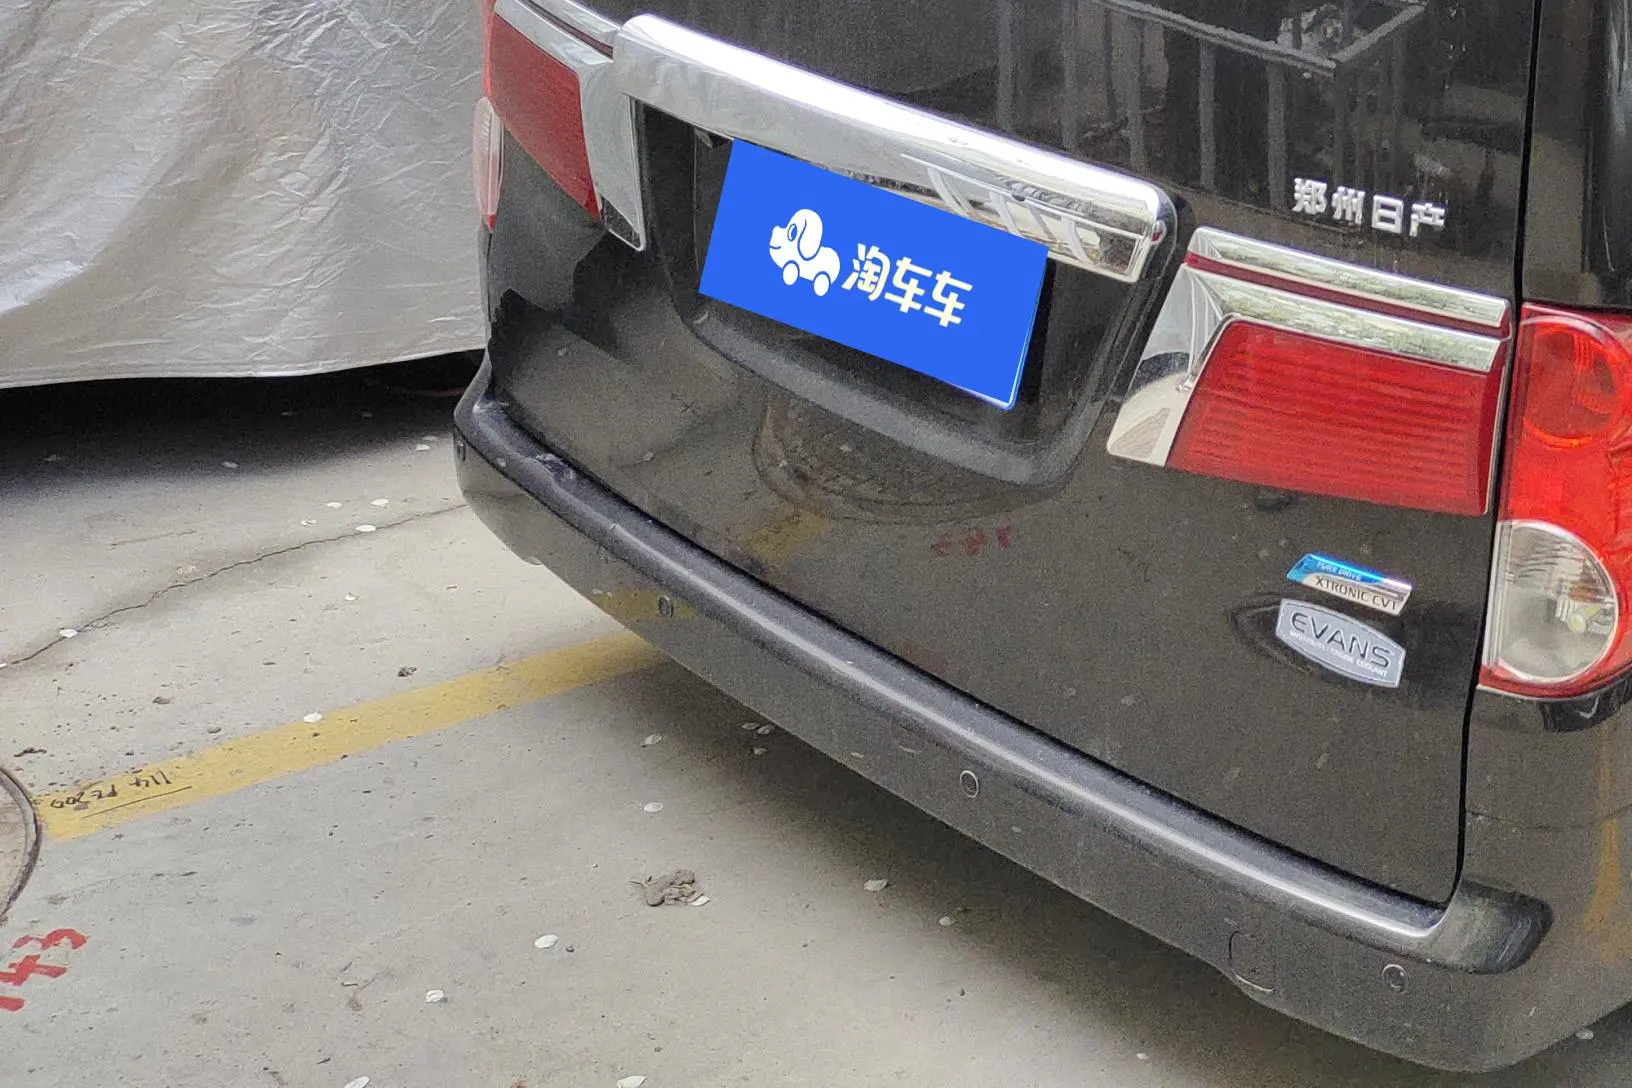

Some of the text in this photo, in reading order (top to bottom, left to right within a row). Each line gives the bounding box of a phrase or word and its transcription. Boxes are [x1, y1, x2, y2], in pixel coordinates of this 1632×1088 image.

[1292, 177, 1446, 237] 郑州日产
[1314, 576, 1398, 611] XTRONIC CVT
[1291, 612, 1391, 668] EVANS
